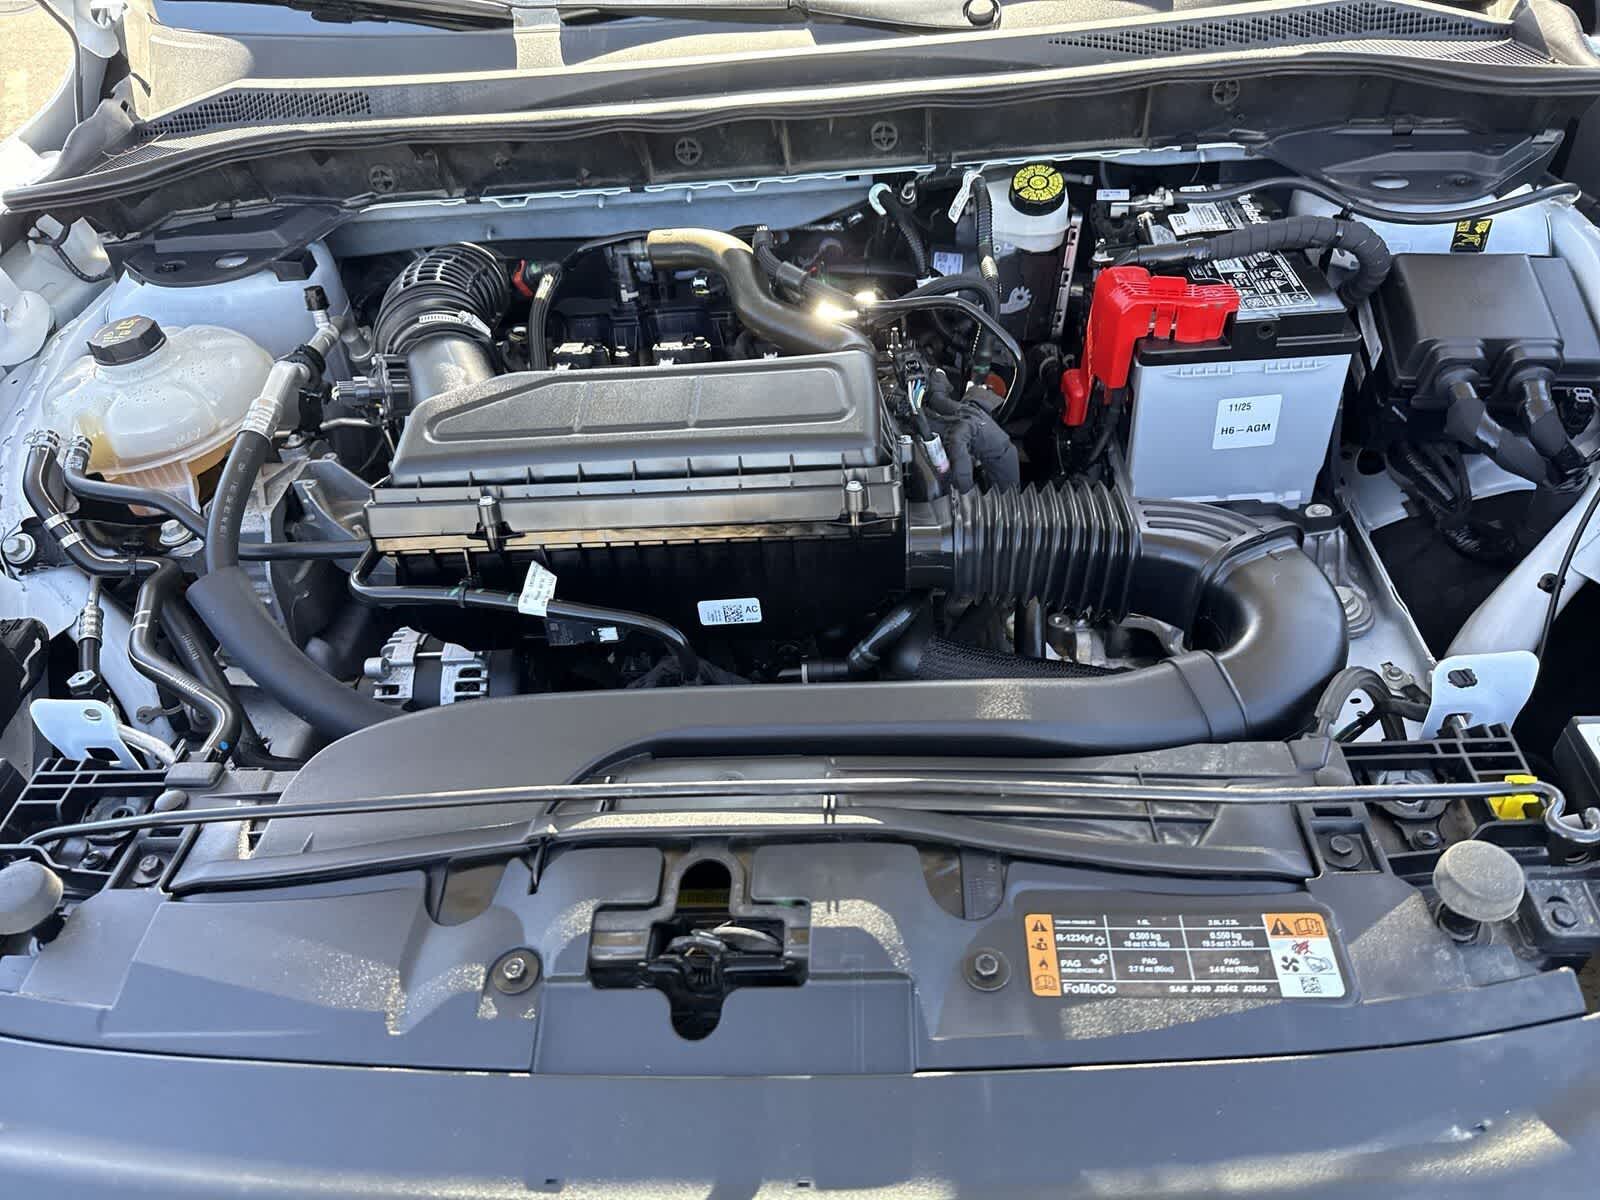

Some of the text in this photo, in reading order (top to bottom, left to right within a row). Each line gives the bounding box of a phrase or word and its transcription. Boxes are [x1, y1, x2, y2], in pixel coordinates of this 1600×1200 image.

[1229, 402, 1252, 412] 11/25
[745, 605, 759, 613] AC
[1060, 959, 1081, 967] PAG
[1141, 957, 1158, 965] PAG
[1223, 957, 1241, 965] PAG
[1063, 983, 1116, 994] FoMoCo
[1169, 985, 1188, 993] SAE
